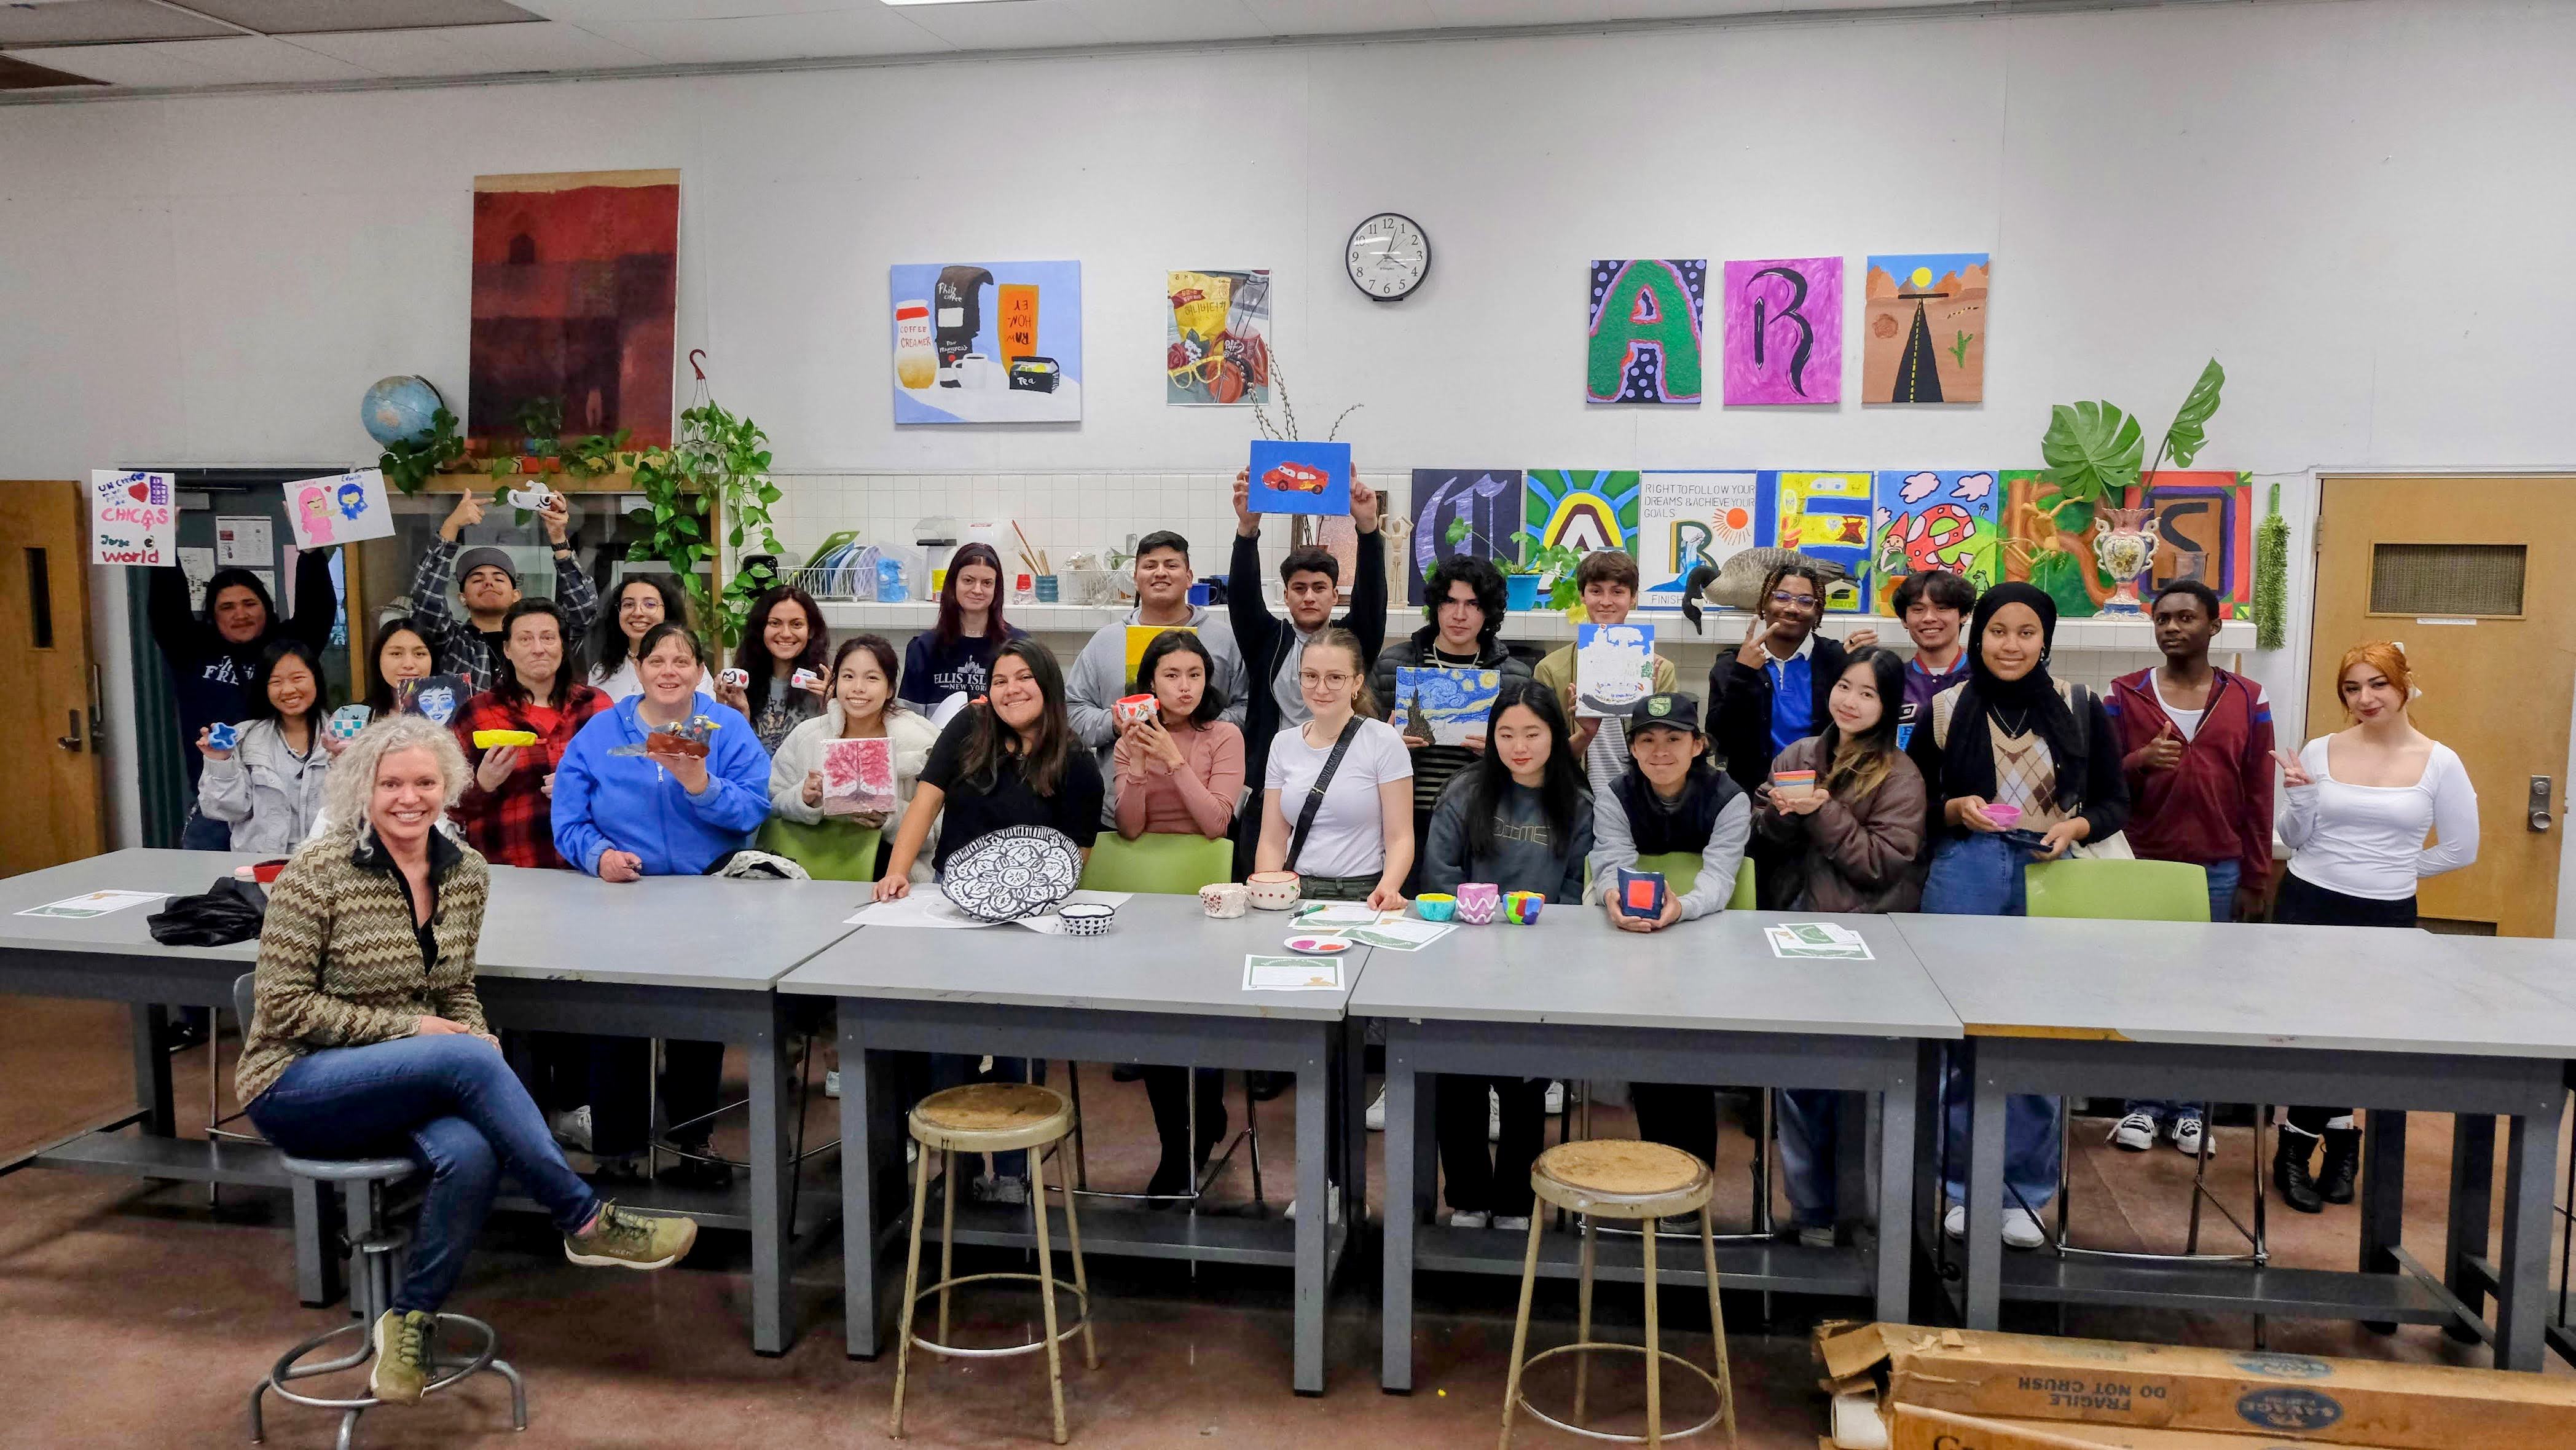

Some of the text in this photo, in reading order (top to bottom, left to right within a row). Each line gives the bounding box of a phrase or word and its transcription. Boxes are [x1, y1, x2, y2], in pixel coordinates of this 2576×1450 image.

[1368, 224, 1377, 234] 11
[1383, 218, 1394, 229] 12
[1401, 223, 1405, 234] 1
[1412, 235, 1418, 246] 2
[1352, 251, 1359, 262] 9
[1416, 251, 1423, 262] 3
[1356, 267, 1364, 277] 8
[1411, 266, 1418, 277] 4
[1368, 279, 1376, 290] 7
[1383, 283, 1391, 294] 6
[1399, 279, 1406, 290] 5
[1746, 267, 1813, 398] R
[900, 337, 932, 348] CREAMER
[1017, 377, 1036, 386] Tea
[1646, 484, 1755, 494] RIGHT TO FOLLOW YOUR
[1644, 496, 1683, 506] DREAMS
[1731, 498, 1755, 507] YOUR
[101, 508, 169, 525] CHICAS
[1644, 508, 1676, 518] GOALS
[101, 549, 159, 564] world
[1652, 594, 1683, 604] FINISH
[934, 672, 964, 684] ELLIS
[2019, 1377, 2166, 1399] DO NOT CRUSH
[2050, 1393, 2131, 1411] FRAGILE
